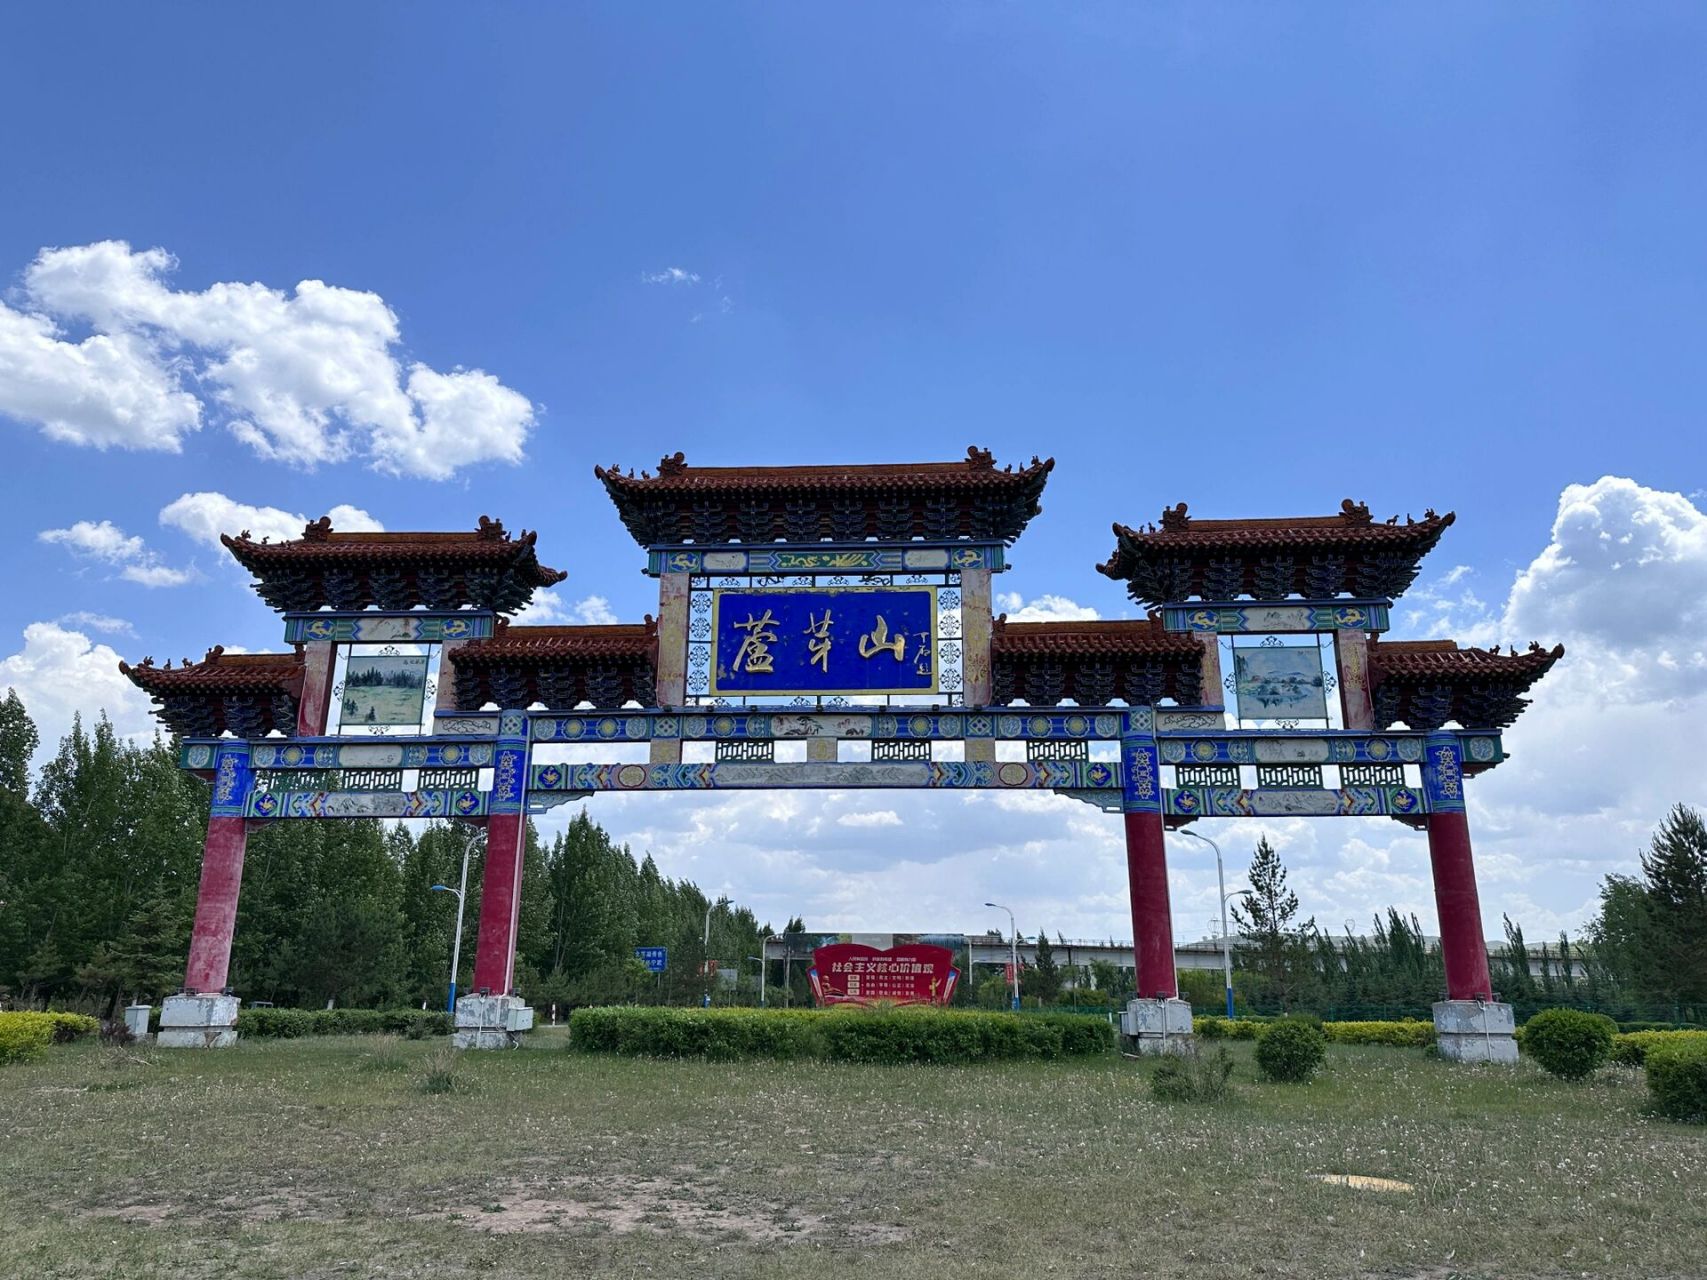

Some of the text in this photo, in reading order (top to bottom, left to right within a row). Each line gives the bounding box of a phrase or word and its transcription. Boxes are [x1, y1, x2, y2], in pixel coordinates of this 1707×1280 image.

[832, 962, 934, 974] 社会主义核心价值观
